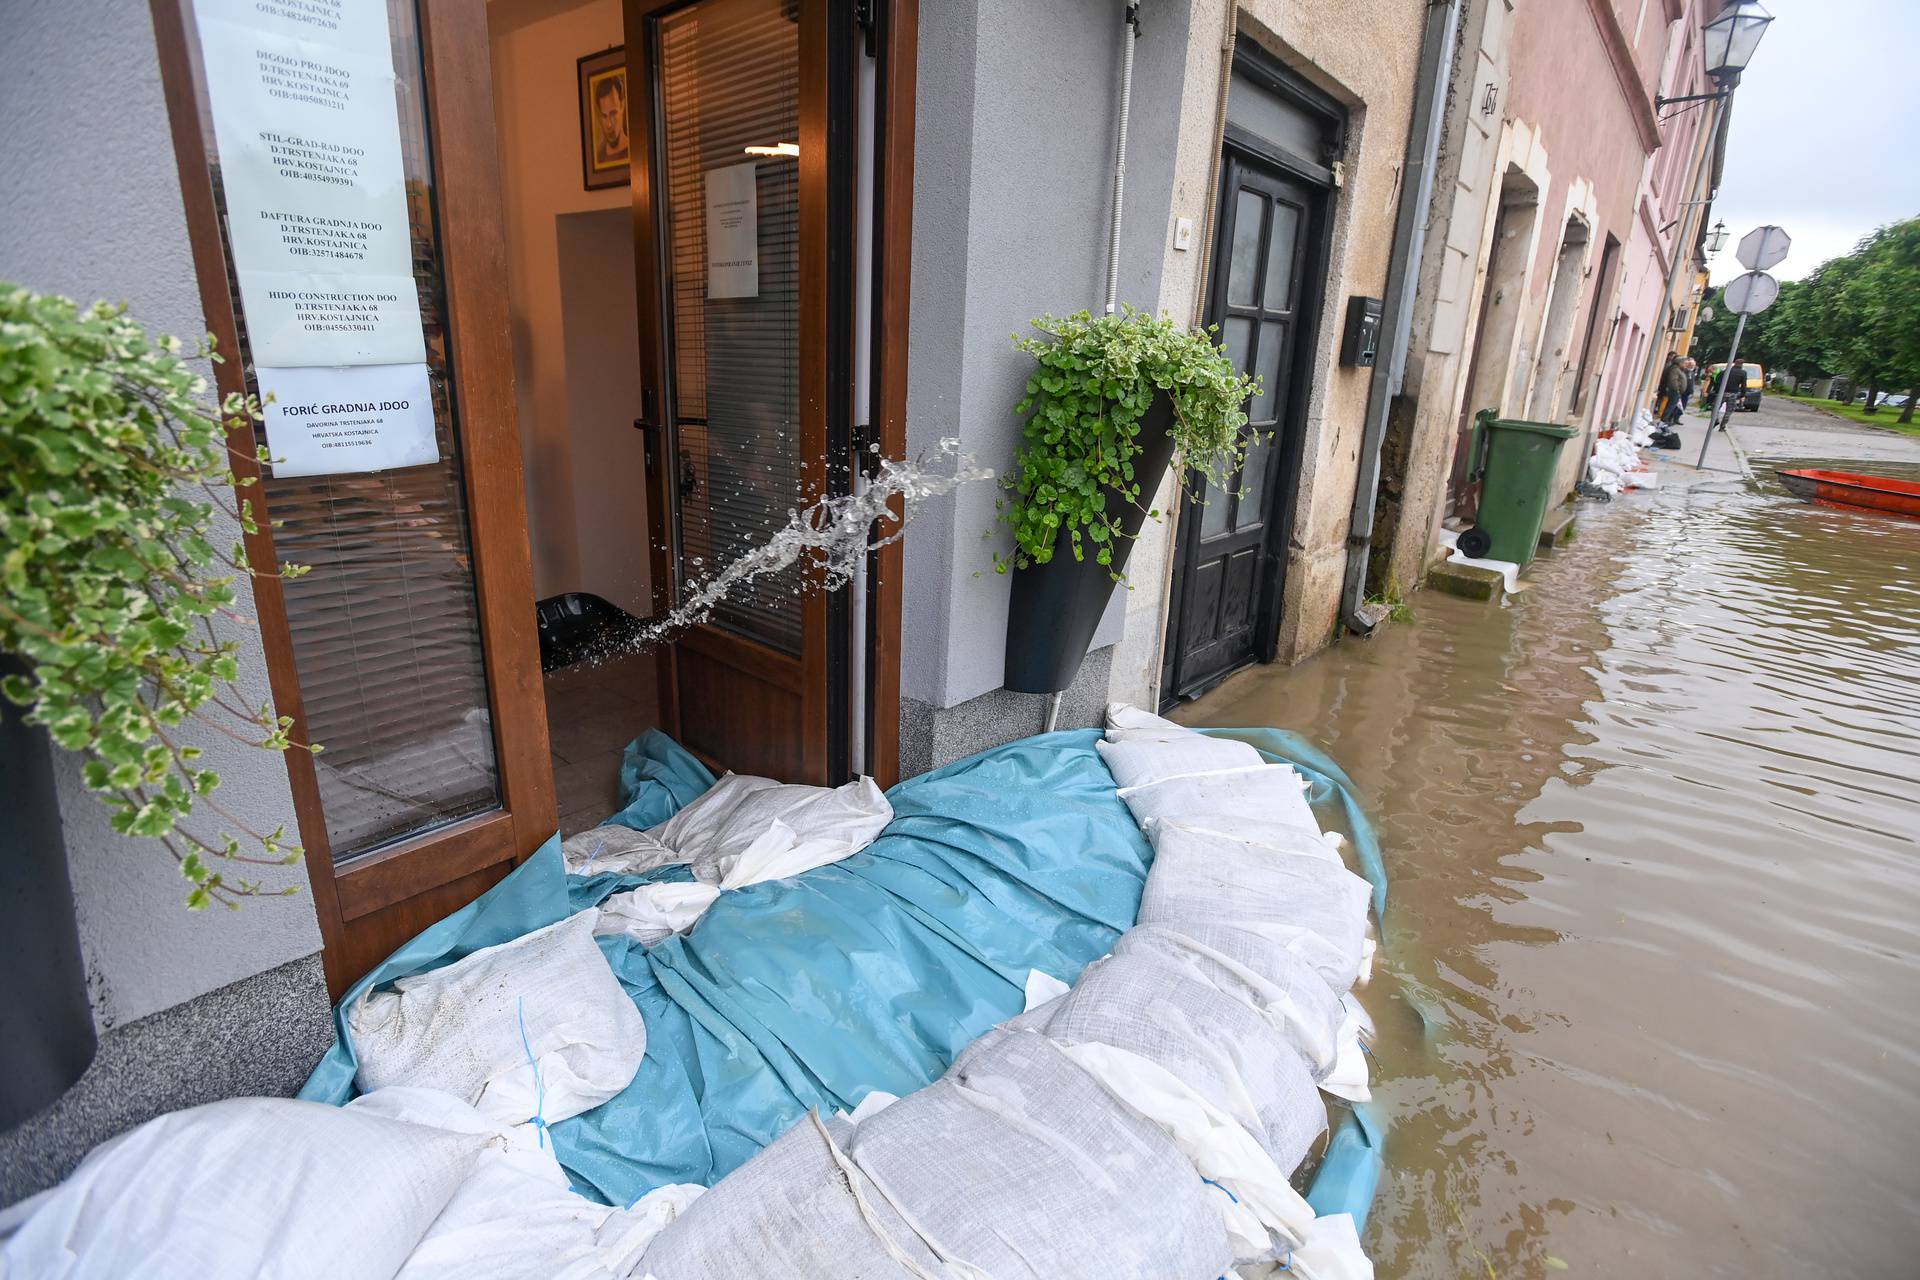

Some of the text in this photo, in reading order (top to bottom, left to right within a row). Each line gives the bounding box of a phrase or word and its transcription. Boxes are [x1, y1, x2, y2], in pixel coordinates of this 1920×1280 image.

[260, 63, 338, 87] D.TRSTENJAKA
[300, 60, 322, 72] PRO
[324, 66, 350, 79] JDOO
[262, 75, 349, 101] HRV.KOSTAJNICA
[259, 132, 365, 156] STIL-GRAD-RAD DOO
[270, 145, 358, 167] D.TRSTENJAKA 68
[273, 156, 358, 177] HRV.KOSTAJNICA
[280, 168, 354, 187] OIB:40354939391
[260, 211, 382, 232] DAFTURA GRADNJA DOO
[281, 224, 367, 240] D.TRSTENJAKA 68
[282, 235, 368, 250] HRV.KOSTAJNICA
[289, 247, 364, 260] OIB:32571484678
[269, 291, 397, 302] HIDO CONSTRUCTION DOO
[295, 302, 378, 312] D.TRSTENJAKA 68
[297, 313, 379, 322] HRV.KOSTAJNICA
[304, 323, 375, 332] OIB:04556330411
[282, 400, 410, 416] FORIĆ GRADNJA JDOO
[306, 420, 338, 429] DAVORINA
[312, 429, 379, 439] HRVATSKA KOSTAJNICA
